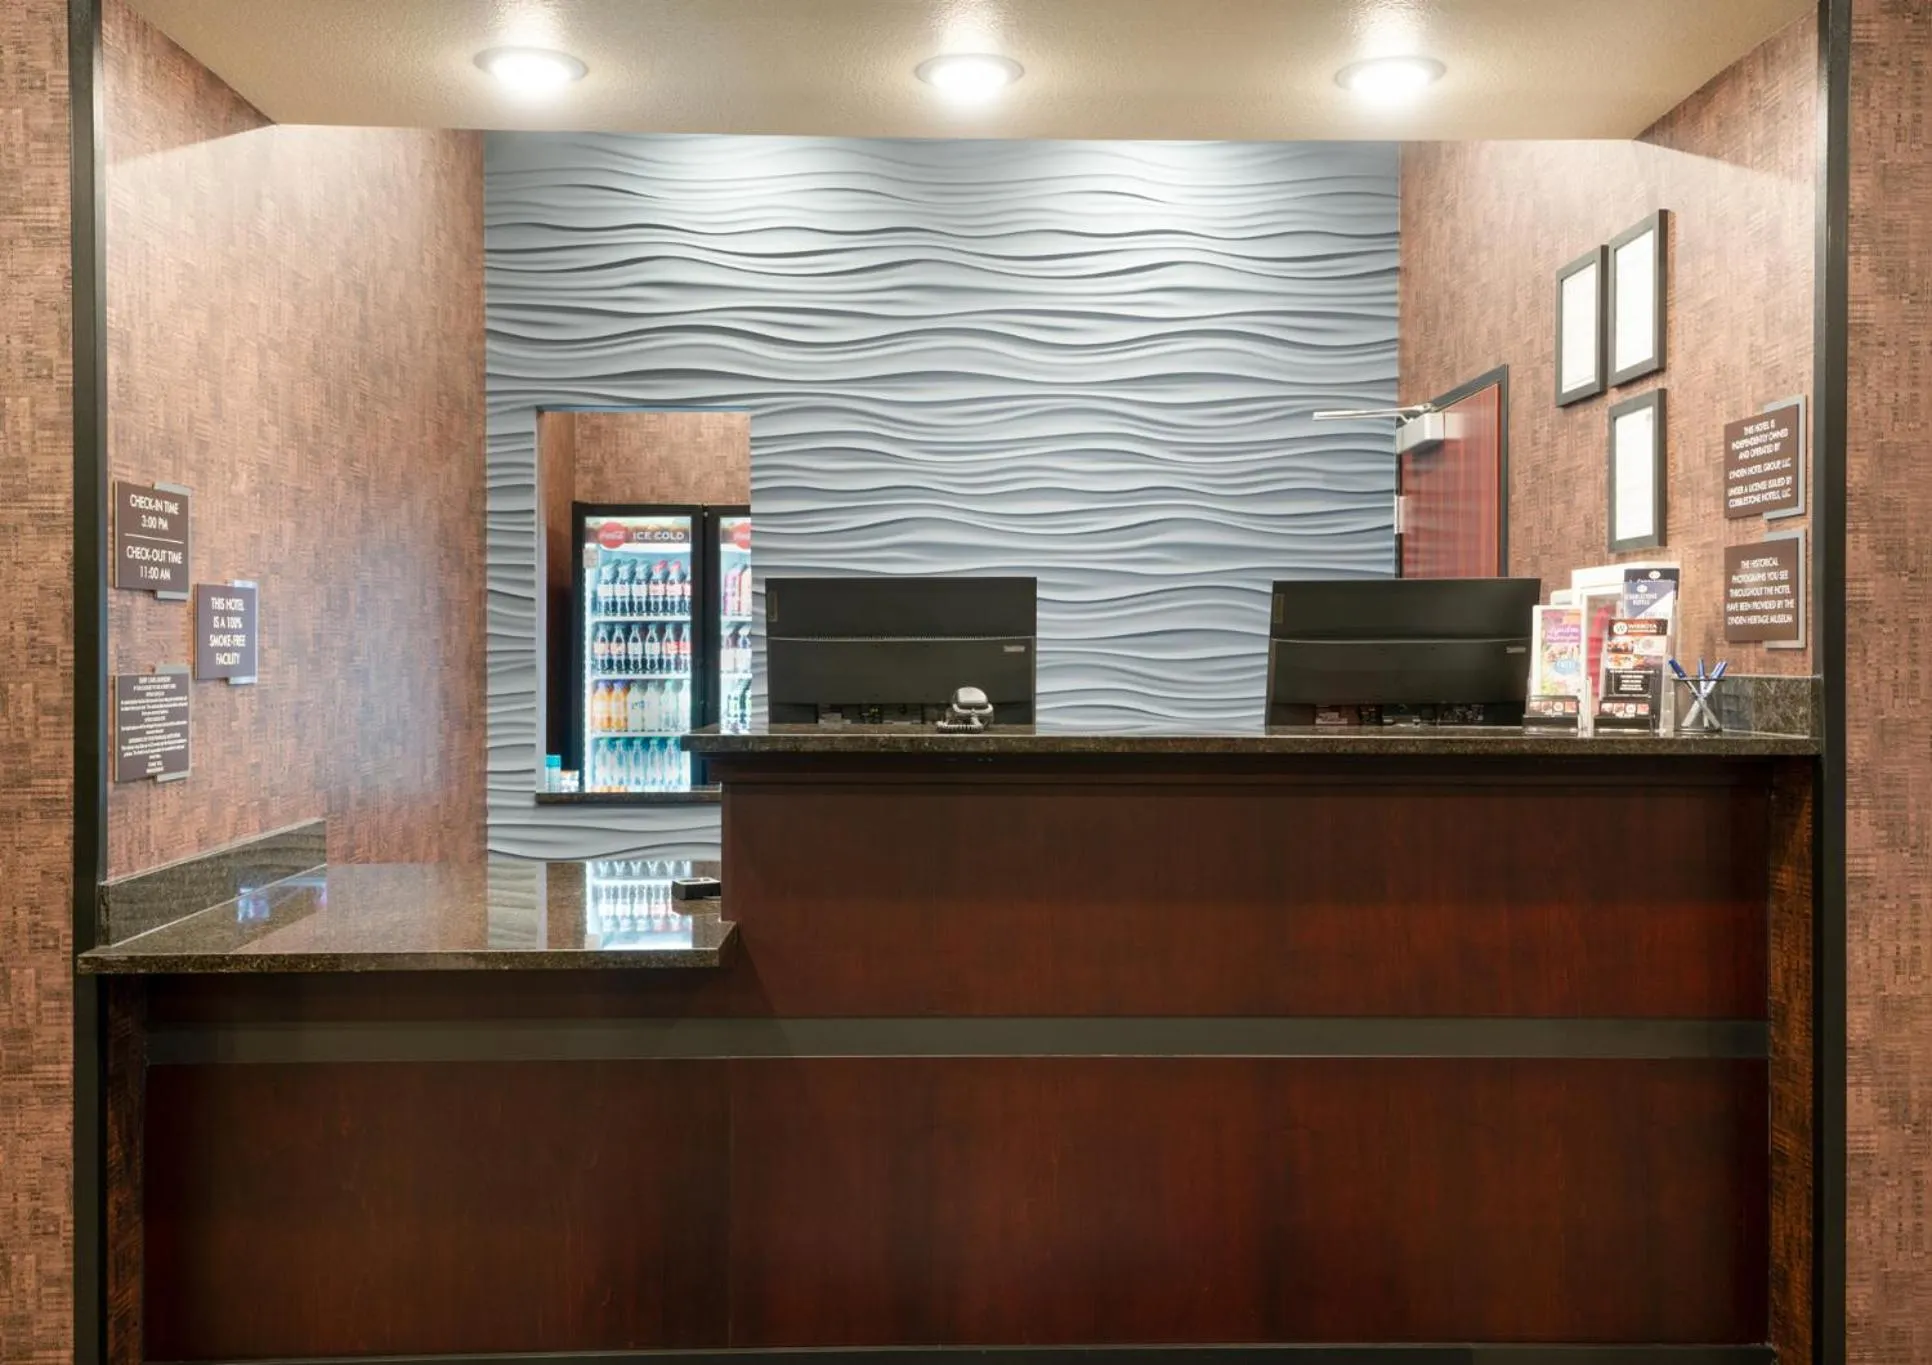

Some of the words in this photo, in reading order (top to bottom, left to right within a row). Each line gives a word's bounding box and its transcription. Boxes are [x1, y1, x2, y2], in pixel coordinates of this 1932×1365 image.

[1754, 421, 1770, 432] HOTEL
[1732, 435, 1768, 451] INDEPENDENTLY
[1769, 428, 1788, 440] OWNED
[1738, 450, 1750, 460] AND
[1751, 444, 1774, 458] OPERATED
[1774, 442, 1780, 452] BY
[1748, 464, 1763, 475] HOTEL
[130, 494, 163, 512] CHECK-IN
[164, 501, 179, 515] TIME
[142, 515, 156, 529] 3:00
[158, 517, 169, 531] PM
[633, 532, 651, 540] ICE
[654, 531, 684, 540] COLD
[126, 546, 167, 562] CHECK-OUT
[167, 551, 182, 564] TIME
[1741, 560, 1749, 569] THE
[1750, 557, 1778, 568] HISTORICAL
[140, 566, 158, 580] 11:00
[160, 568, 171, 580] AM
[1732, 572, 1766, 584] PHOTOGRAPHS
[1767, 571, 1778, 581] YOU
[1779, 570, 1789, 580] SEE
[1730, 587, 1764, 598] THROUGHOUT
[1764, 586, 1773, 595] THE
[1775, 584, 1791, 594] HOTEL
[211, 597, 224, 610] THIS
[226, 598, 244, 611] HOTEL
[1726, 602, 1739, 612] HAVE
[1739, 602, 1751, 611] BEEN
[1752, 600, 1776, 610] PROVIDED
[1784, 599, 1794, 608] THE
[213, 616, 219, 628] IS
[220, 616, 226, 628] A
[1747, 615, 1769, 624] HERITAGE
[209, 634, 246, 648] SMOKE-FREE
[216, 652, 240, 665] FACILITY
